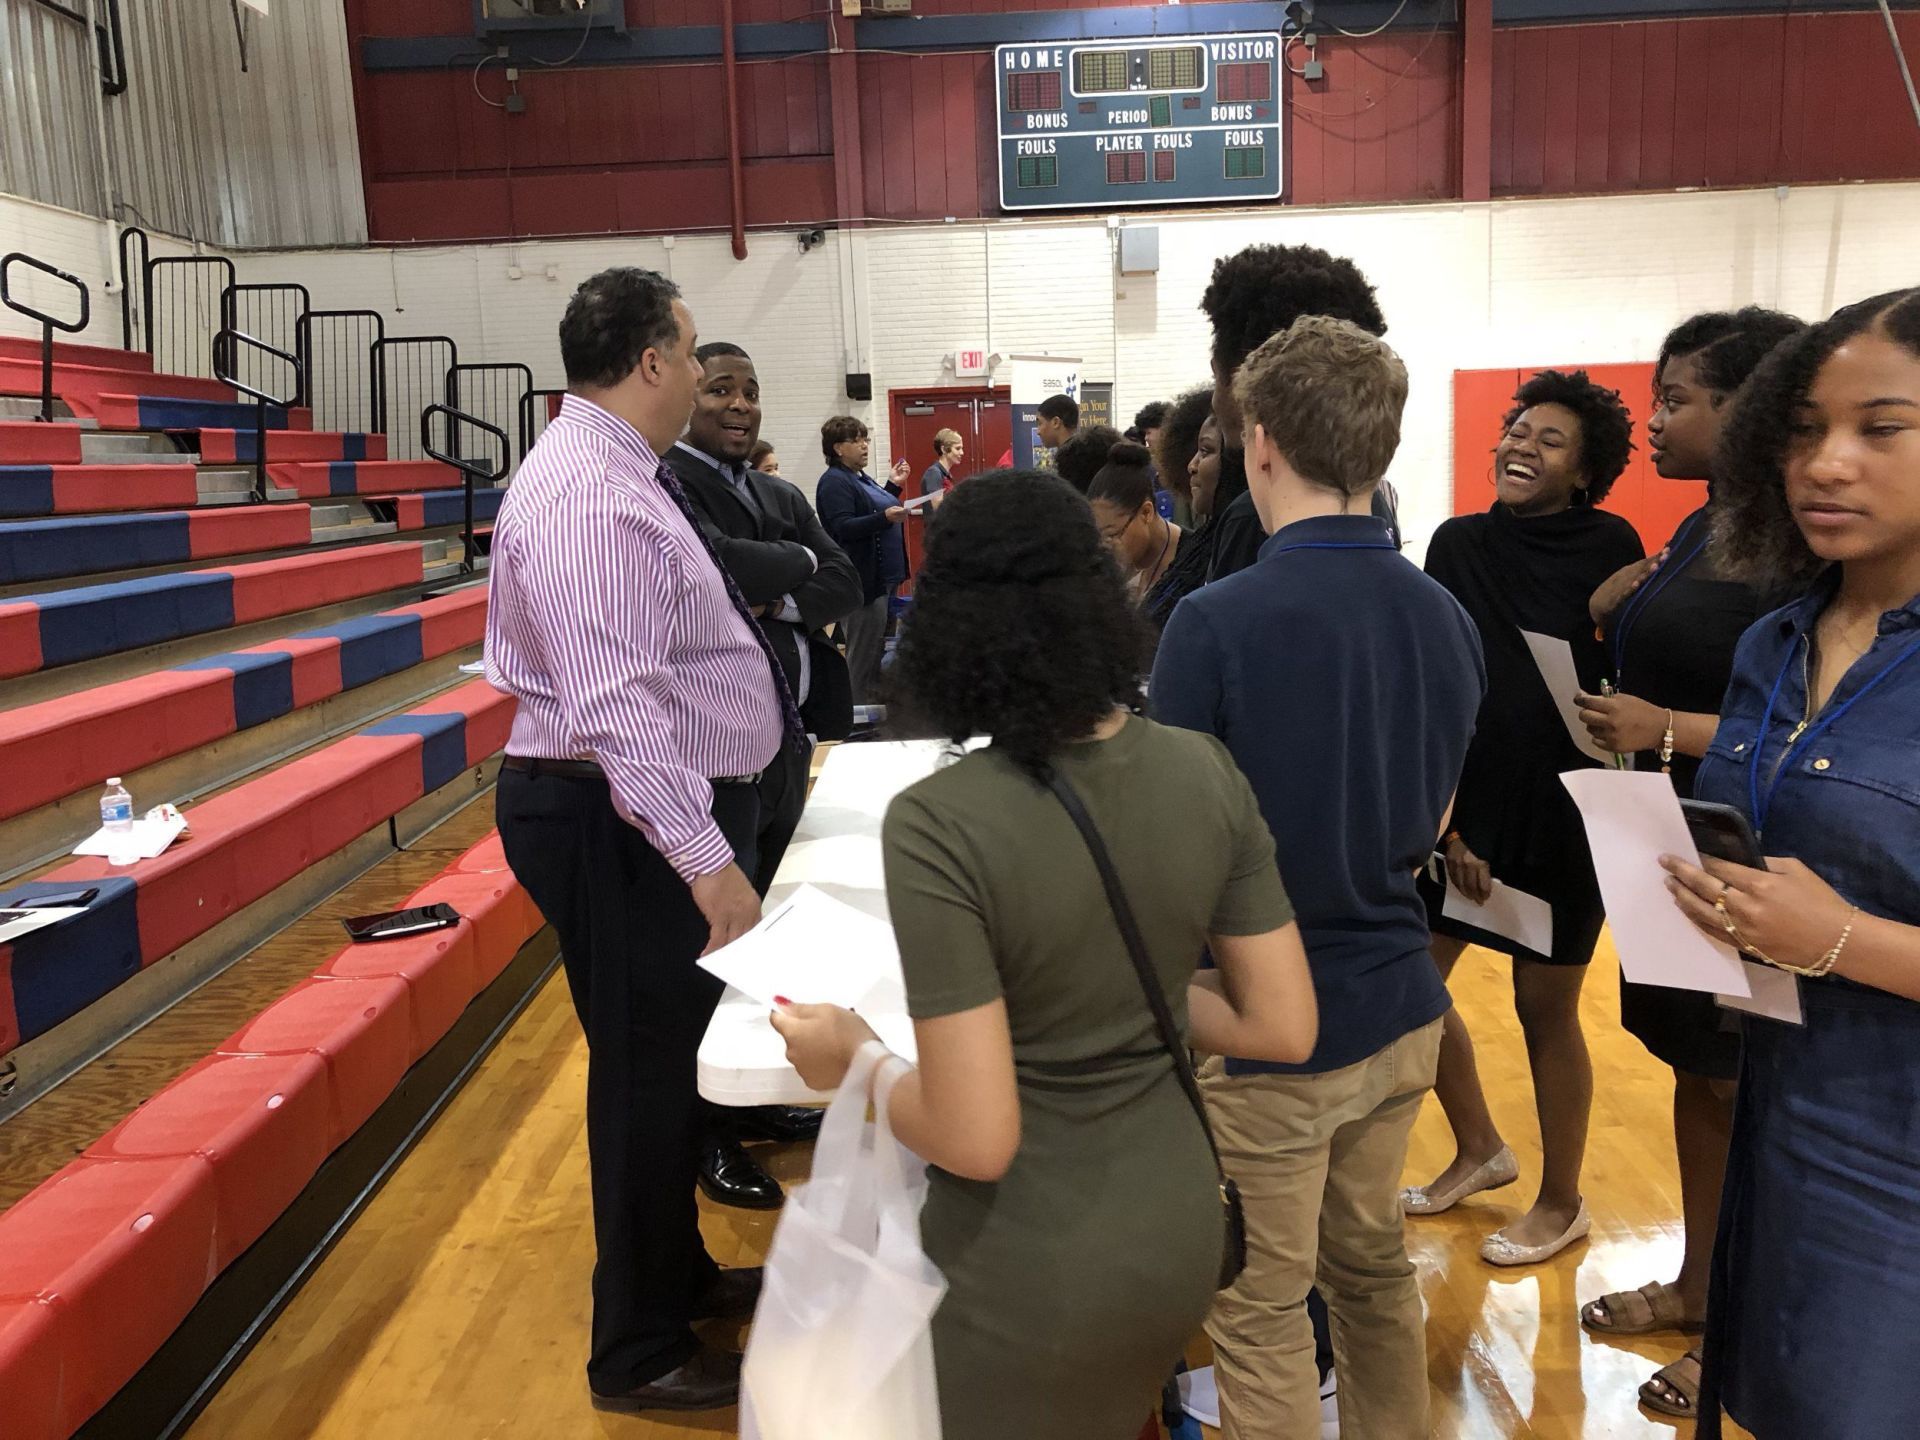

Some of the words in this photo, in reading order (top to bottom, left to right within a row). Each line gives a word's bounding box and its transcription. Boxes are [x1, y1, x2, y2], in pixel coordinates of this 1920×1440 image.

[1211, 41, 1274, 60] VISITOR
[1005, 50, 1063, 69] HOME
[1027, 113, 1068, 128] BONUS
[1108, 110, 1148, 124] PERIOD
[1211, 105, 1252, 121] BONUS
[1096, 135, 1143, 151] PLAYER
[1154, 133, 1192, 148] FOULS
[1225, 130, 1263, 146] FOULS
[1017, 139, 1056, 154] FOULS
[962, 351, 983, 369] EXIT
[1091, 400, 1107, 411] Your
